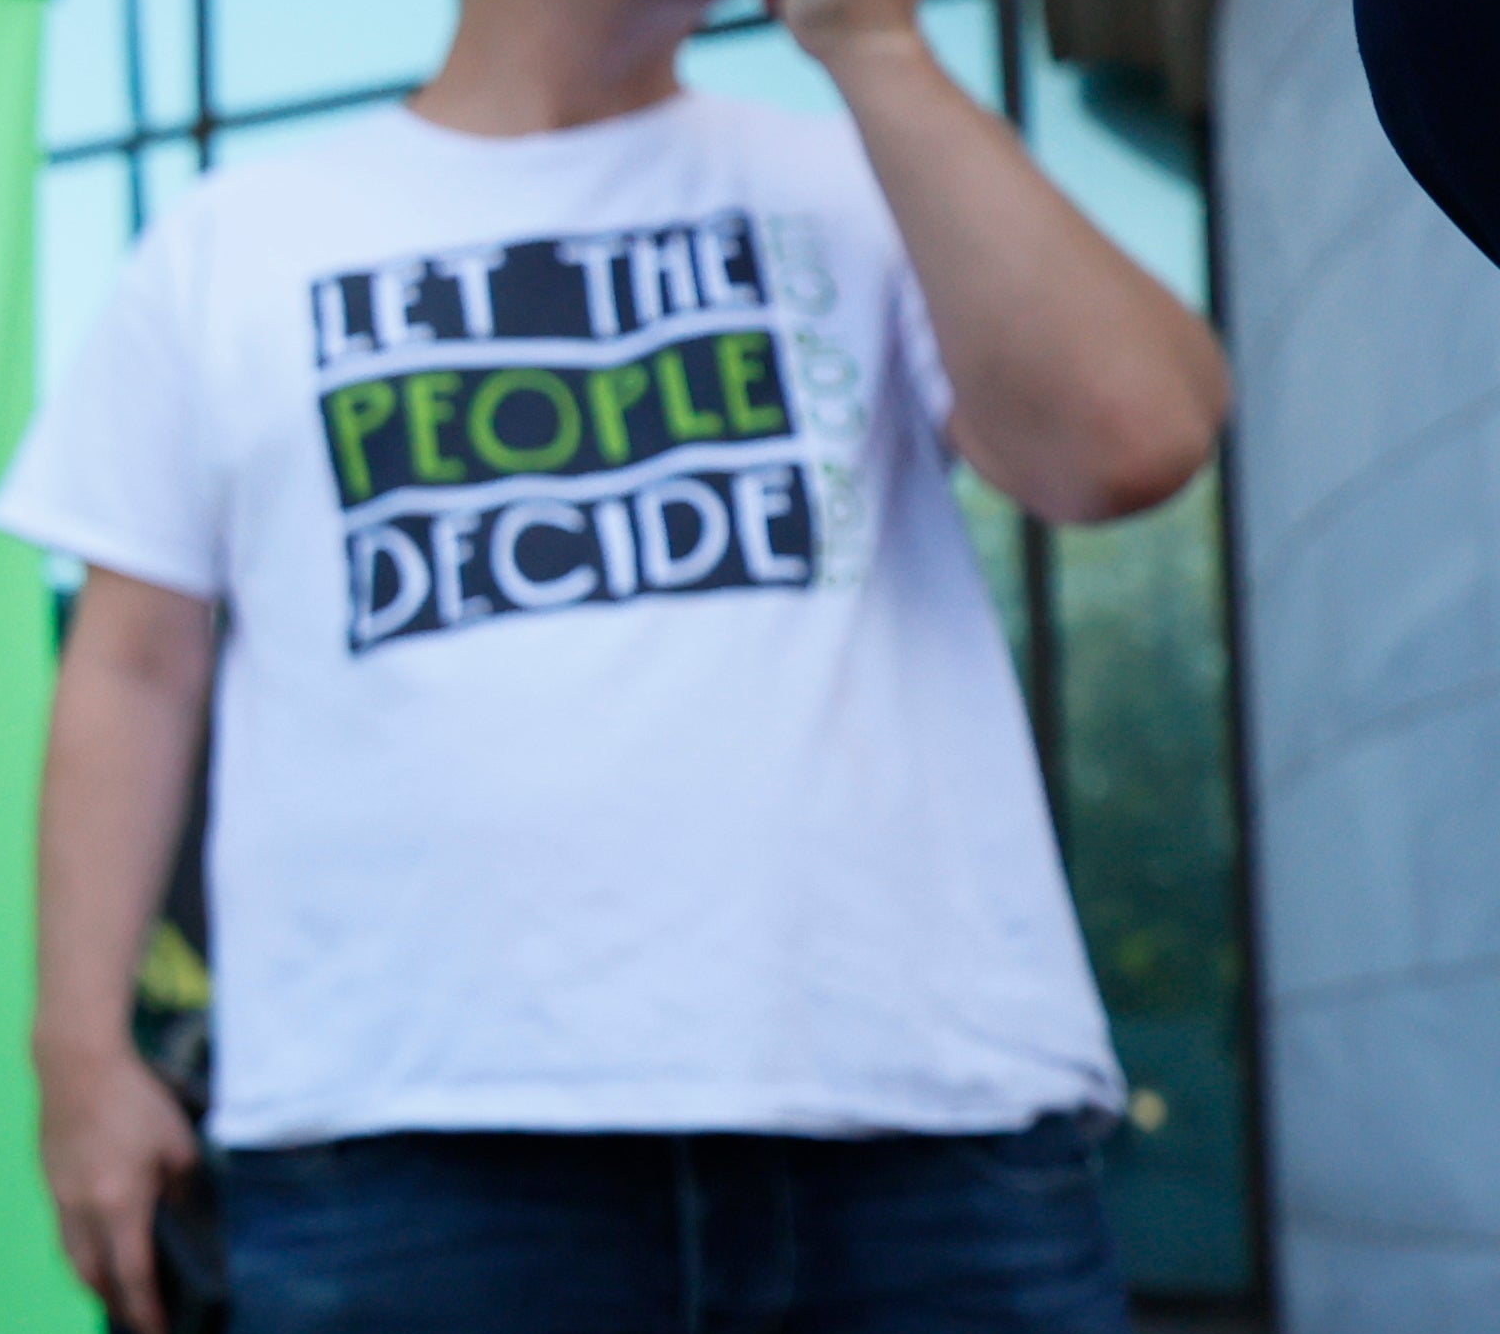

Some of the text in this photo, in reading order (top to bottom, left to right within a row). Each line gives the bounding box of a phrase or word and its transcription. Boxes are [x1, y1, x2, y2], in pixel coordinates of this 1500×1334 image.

[320, 249, 506, 359] LET
[553, 215, 758, 337] THE
[327, 331, 785, 499] PEOPLE
[353, 467, 809, 643] DECIDE
